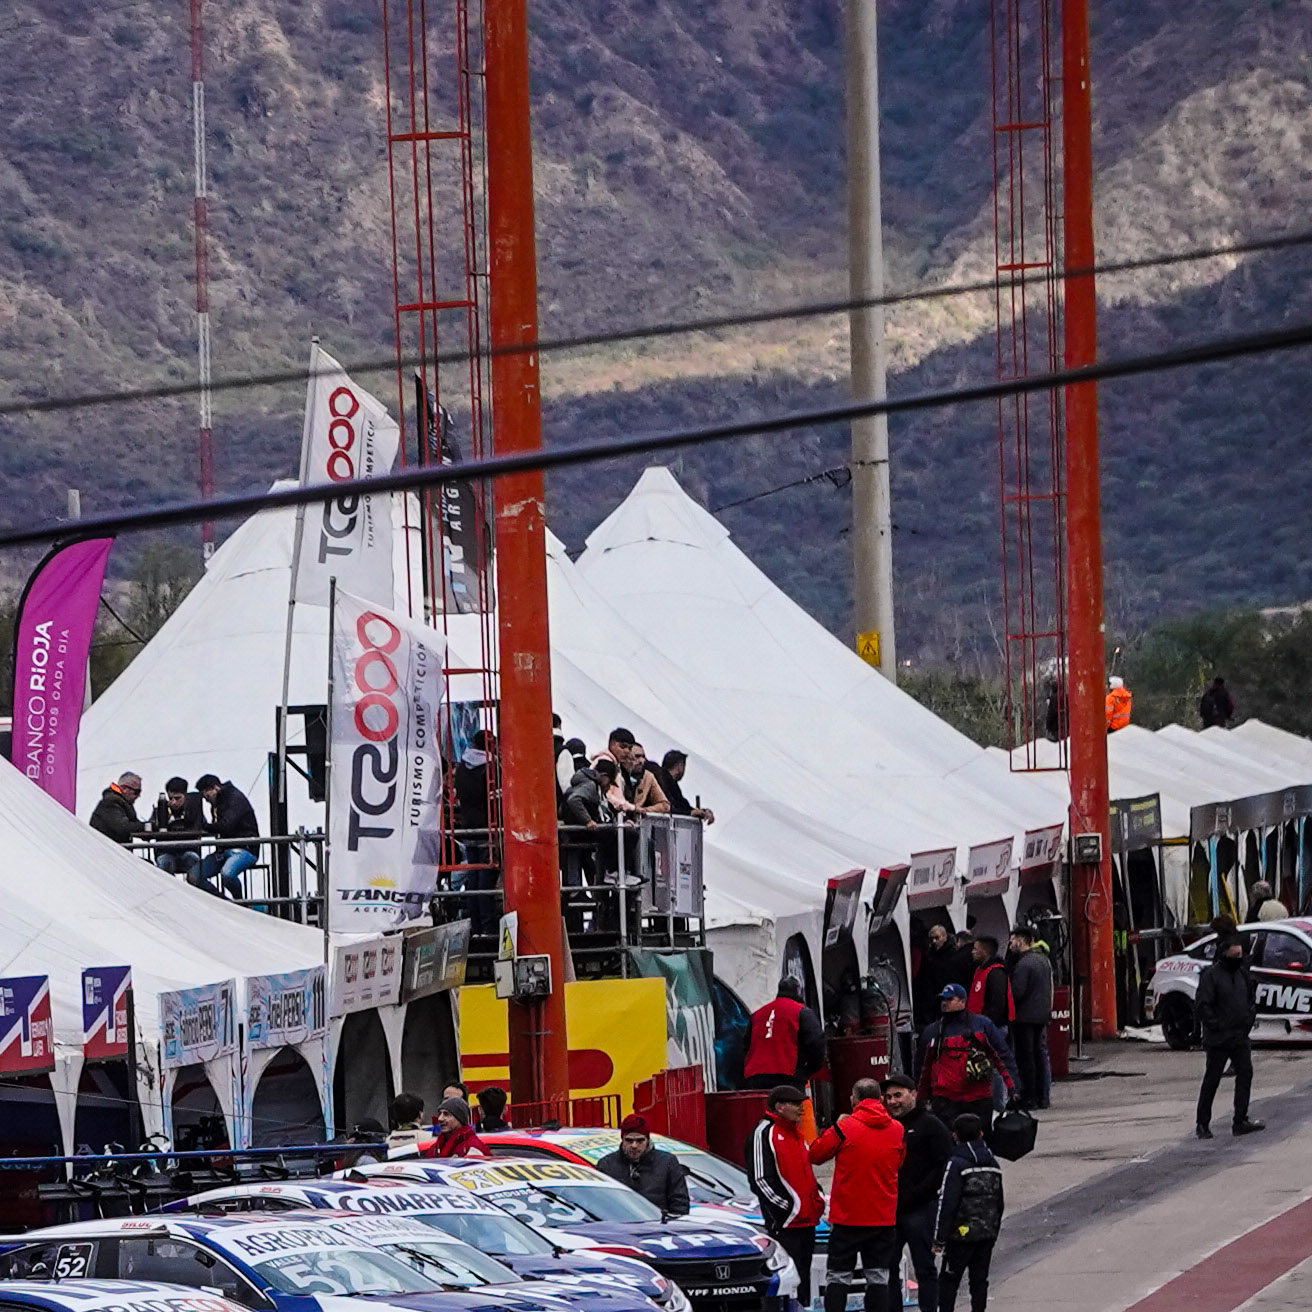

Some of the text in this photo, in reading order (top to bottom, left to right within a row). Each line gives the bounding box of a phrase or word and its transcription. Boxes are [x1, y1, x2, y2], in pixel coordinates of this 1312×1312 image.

[27, 695, 46, 780] BANCO
[47, 660, 65, 774] CON VOS CADA
[347, 610, 402, 852] TC2000
[410, 756, 425, 828] TURISMO
[339, 1192, 495, 1215] CONARPESA
[640, 1233, 744, 1251] YPF
[56, 1257, 86, 1279] 52
[687, 1285, 757, 1297] YPF HONDA
